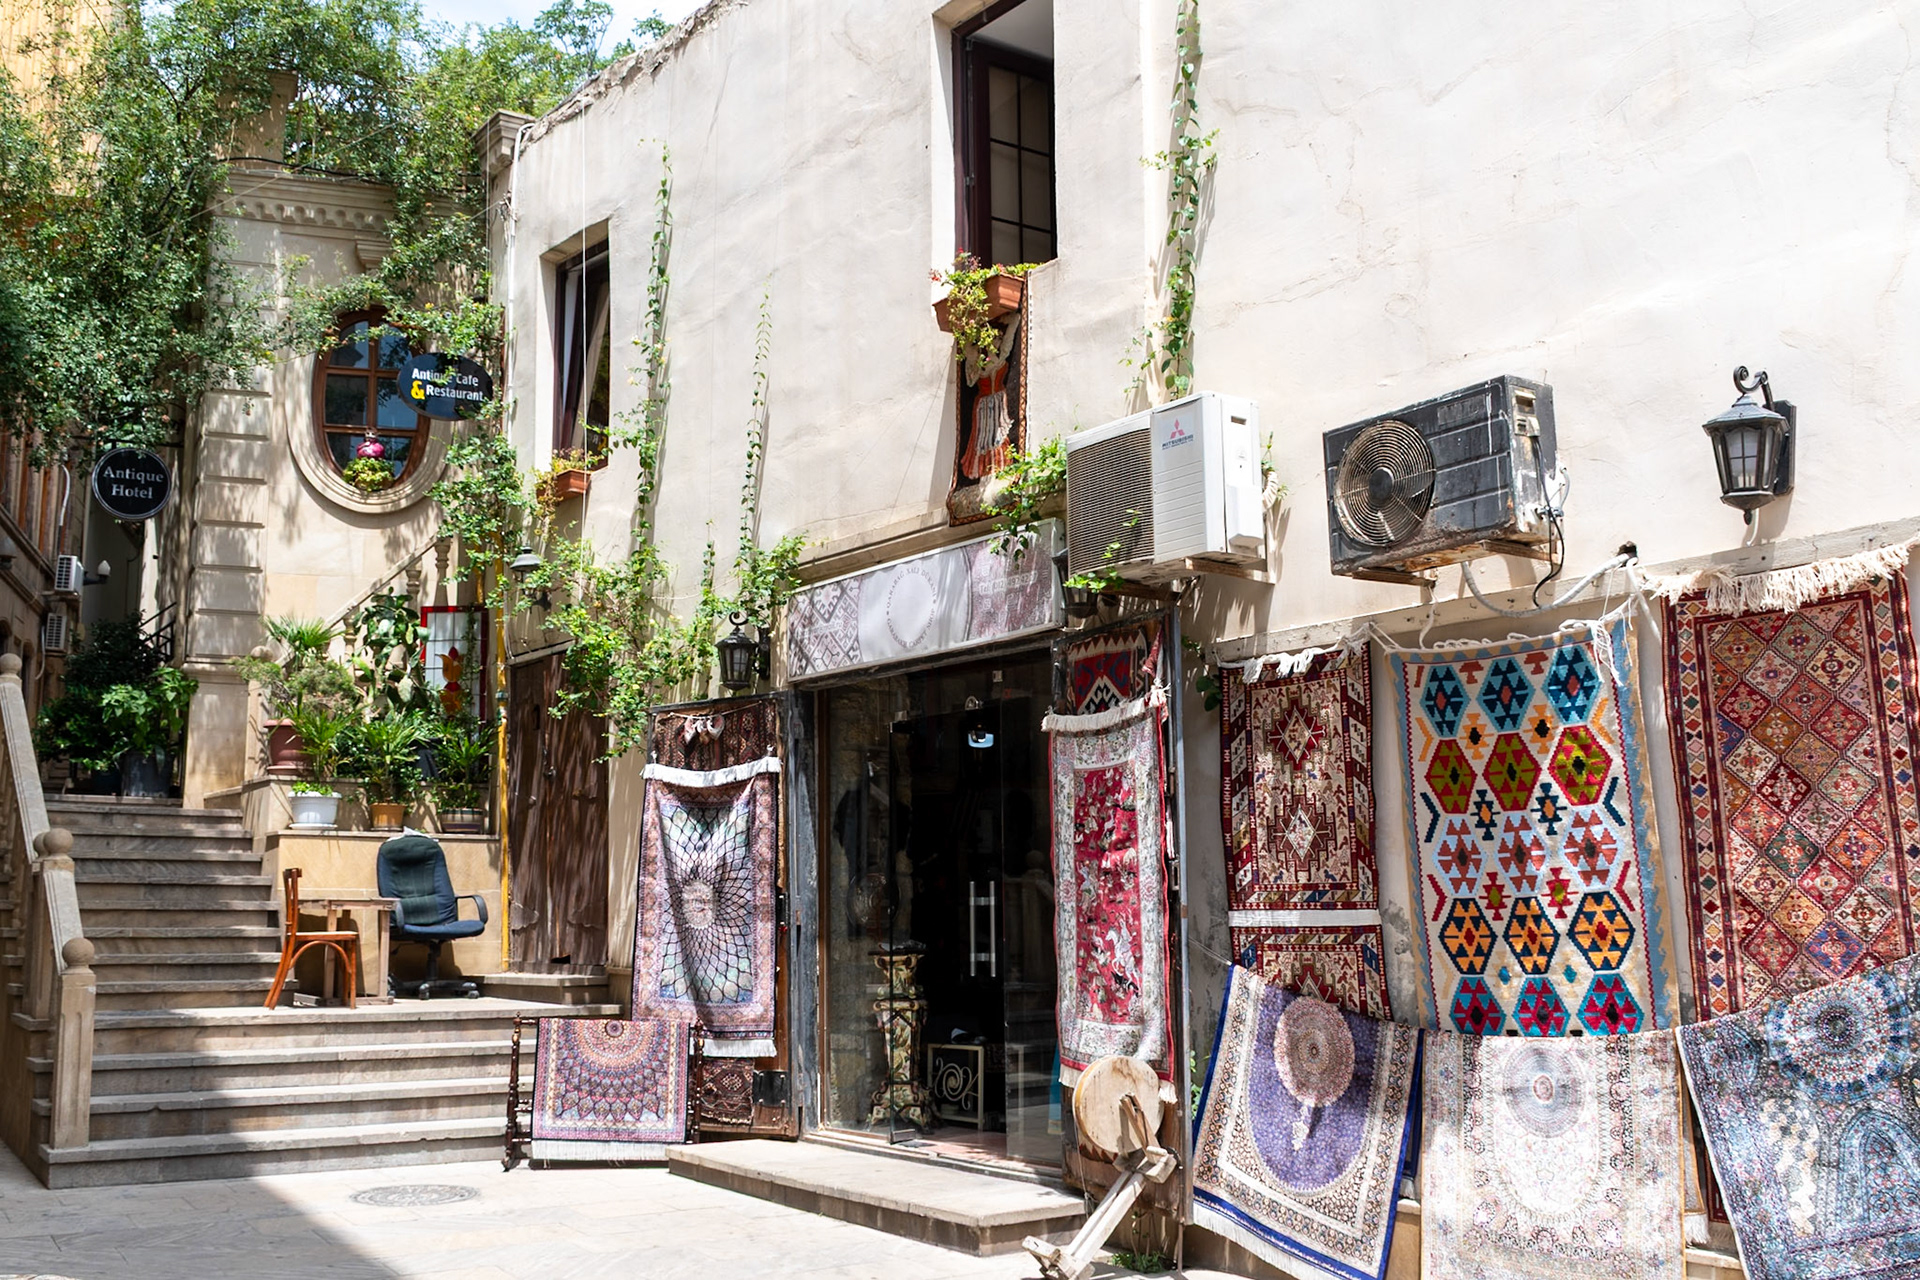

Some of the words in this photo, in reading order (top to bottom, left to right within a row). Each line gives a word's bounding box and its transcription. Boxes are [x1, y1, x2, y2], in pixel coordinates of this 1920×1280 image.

[456, 374, 479, 386] Cafe
[411, 381, 425, 400] &
[426, 385, 483, 401] Restaurant
[103, 466, 164, 484] Antique
[112, 484, 153, 499] Hotel
